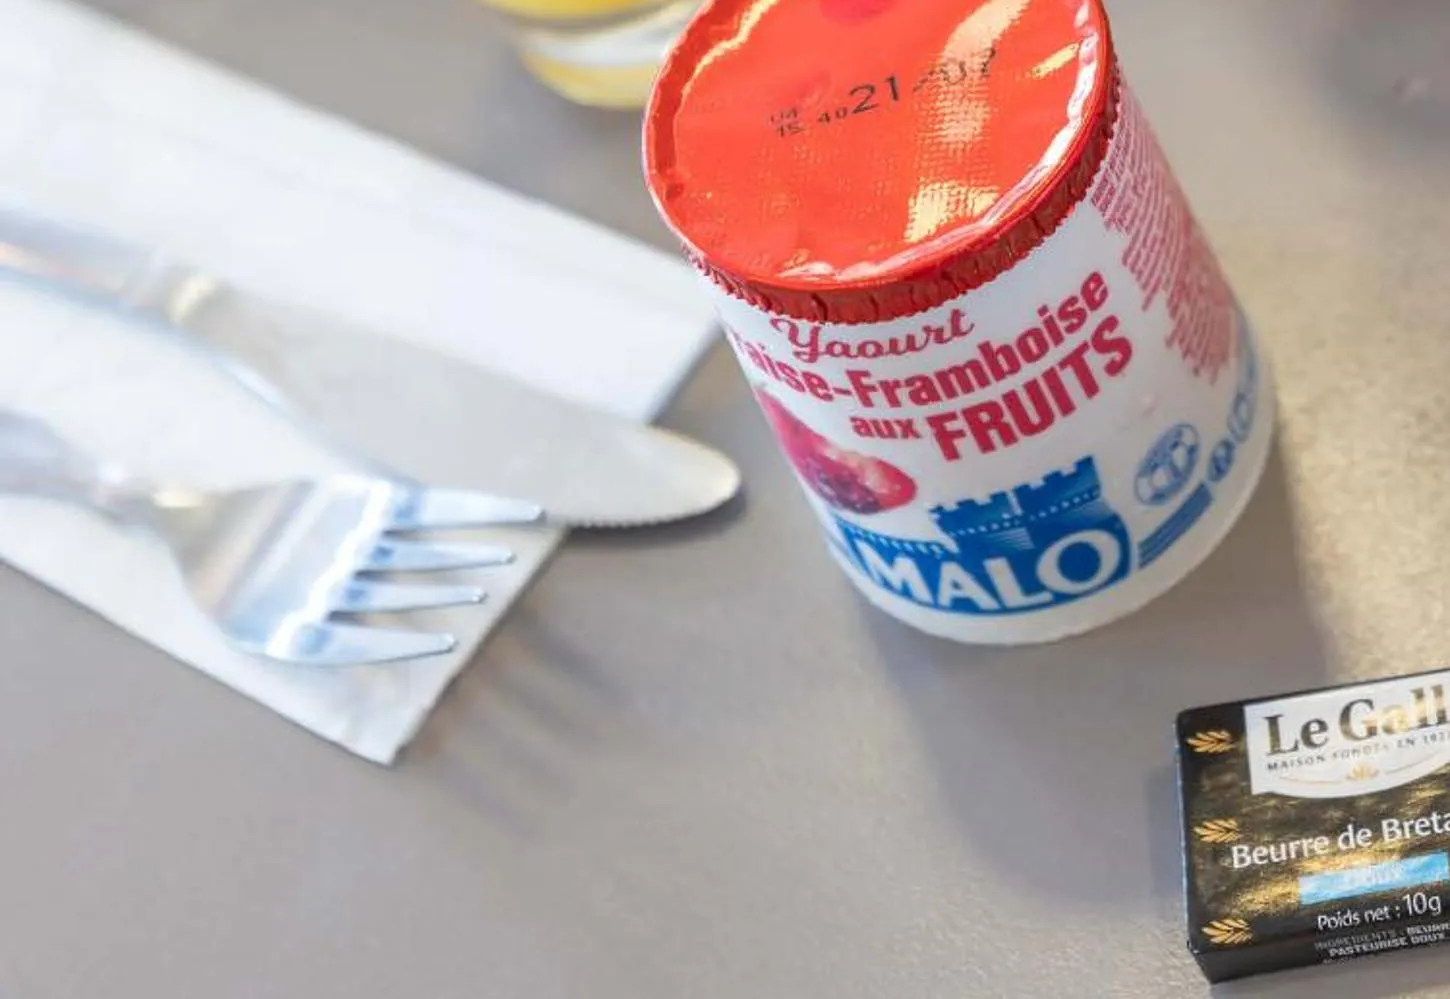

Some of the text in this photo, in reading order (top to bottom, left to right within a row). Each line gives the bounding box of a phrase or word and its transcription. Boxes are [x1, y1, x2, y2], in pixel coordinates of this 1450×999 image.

[771, 308, 975, 363] Yaourt
[850, 415, 921, 440] aux
[926, 313, 1134, 461] FRUITS
[854, 529, 1121, 610] MALO
[1264, 714, 1329, 756] Le
[1266, 753, 1326, 772] MAISON
[1232, 833, 1330, 869] Beurre
[1338, 822, 1373, 850] de
[1317, 908, 1361, 932] Poids
[1364, 905, 1391, 923] net
[1402, 891, 1442, 917] 10g
